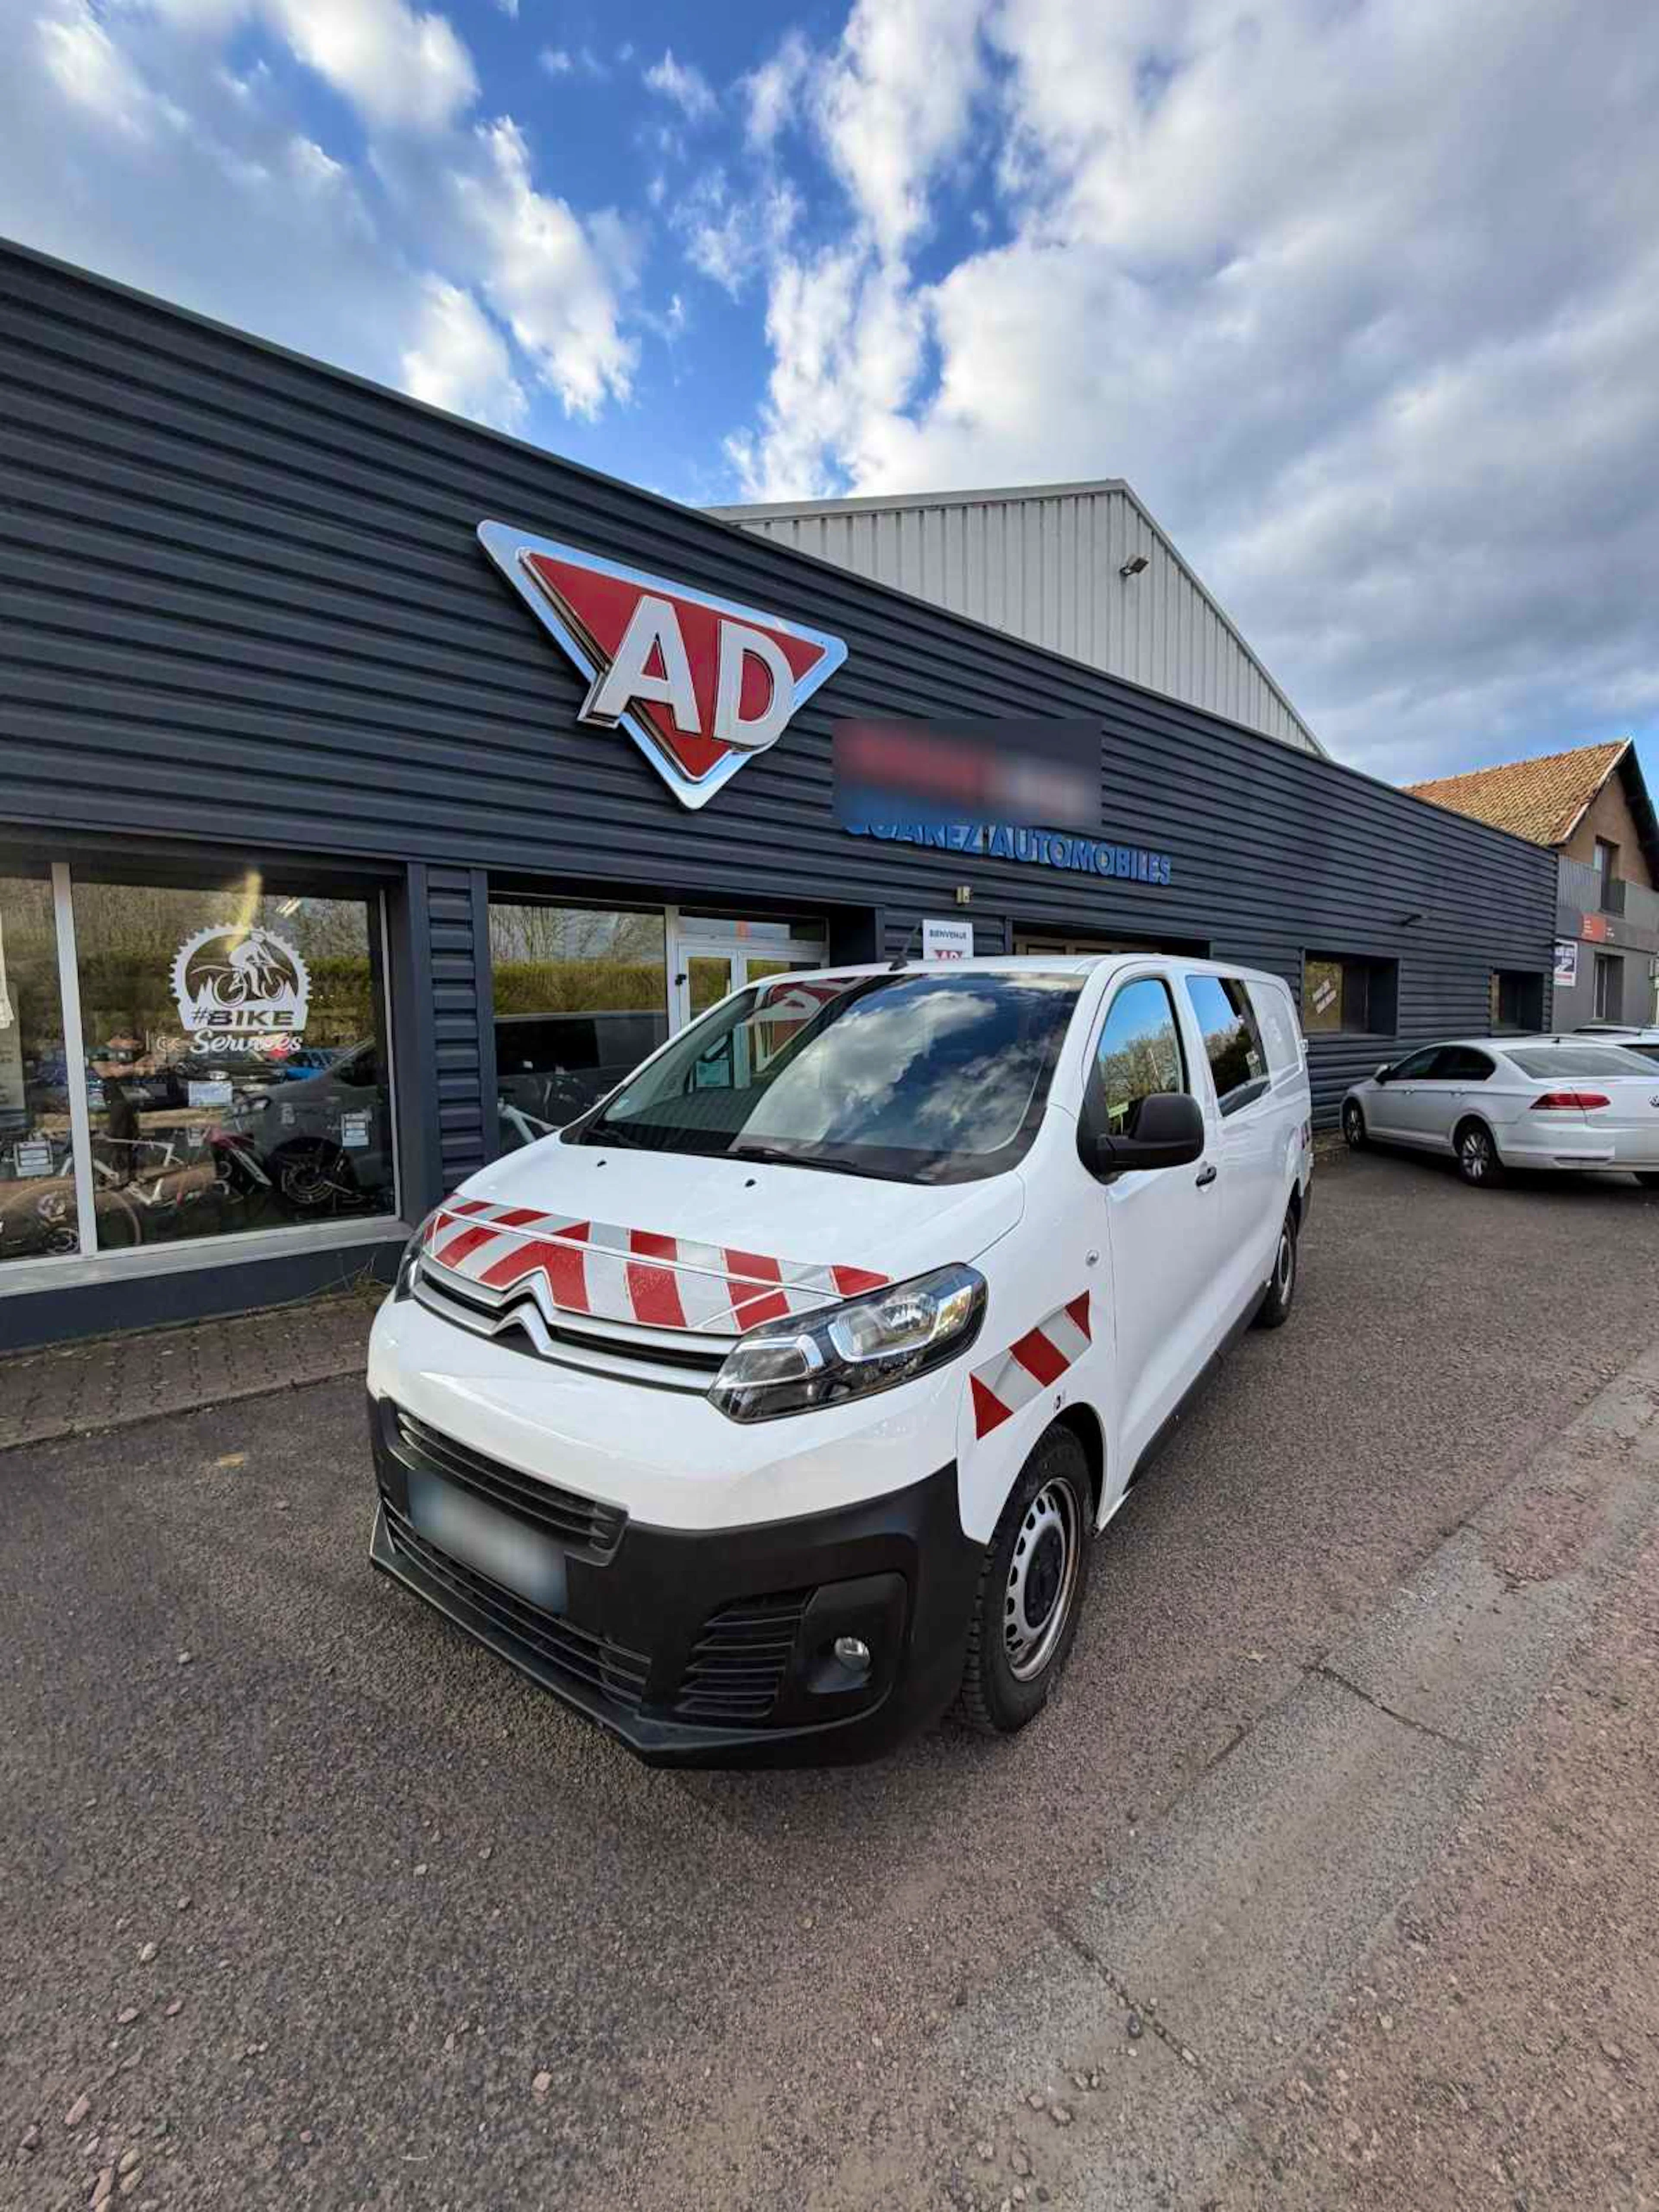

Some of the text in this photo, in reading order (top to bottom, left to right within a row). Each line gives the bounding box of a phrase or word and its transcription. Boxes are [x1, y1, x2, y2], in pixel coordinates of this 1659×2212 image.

[584, 594, 795, 751] AD
[989, 824, 1173, 886] AUTOMOBILES
[191, 1006, 294, 1026] #BIKE
[190, 1028, 303, 1054] Services
